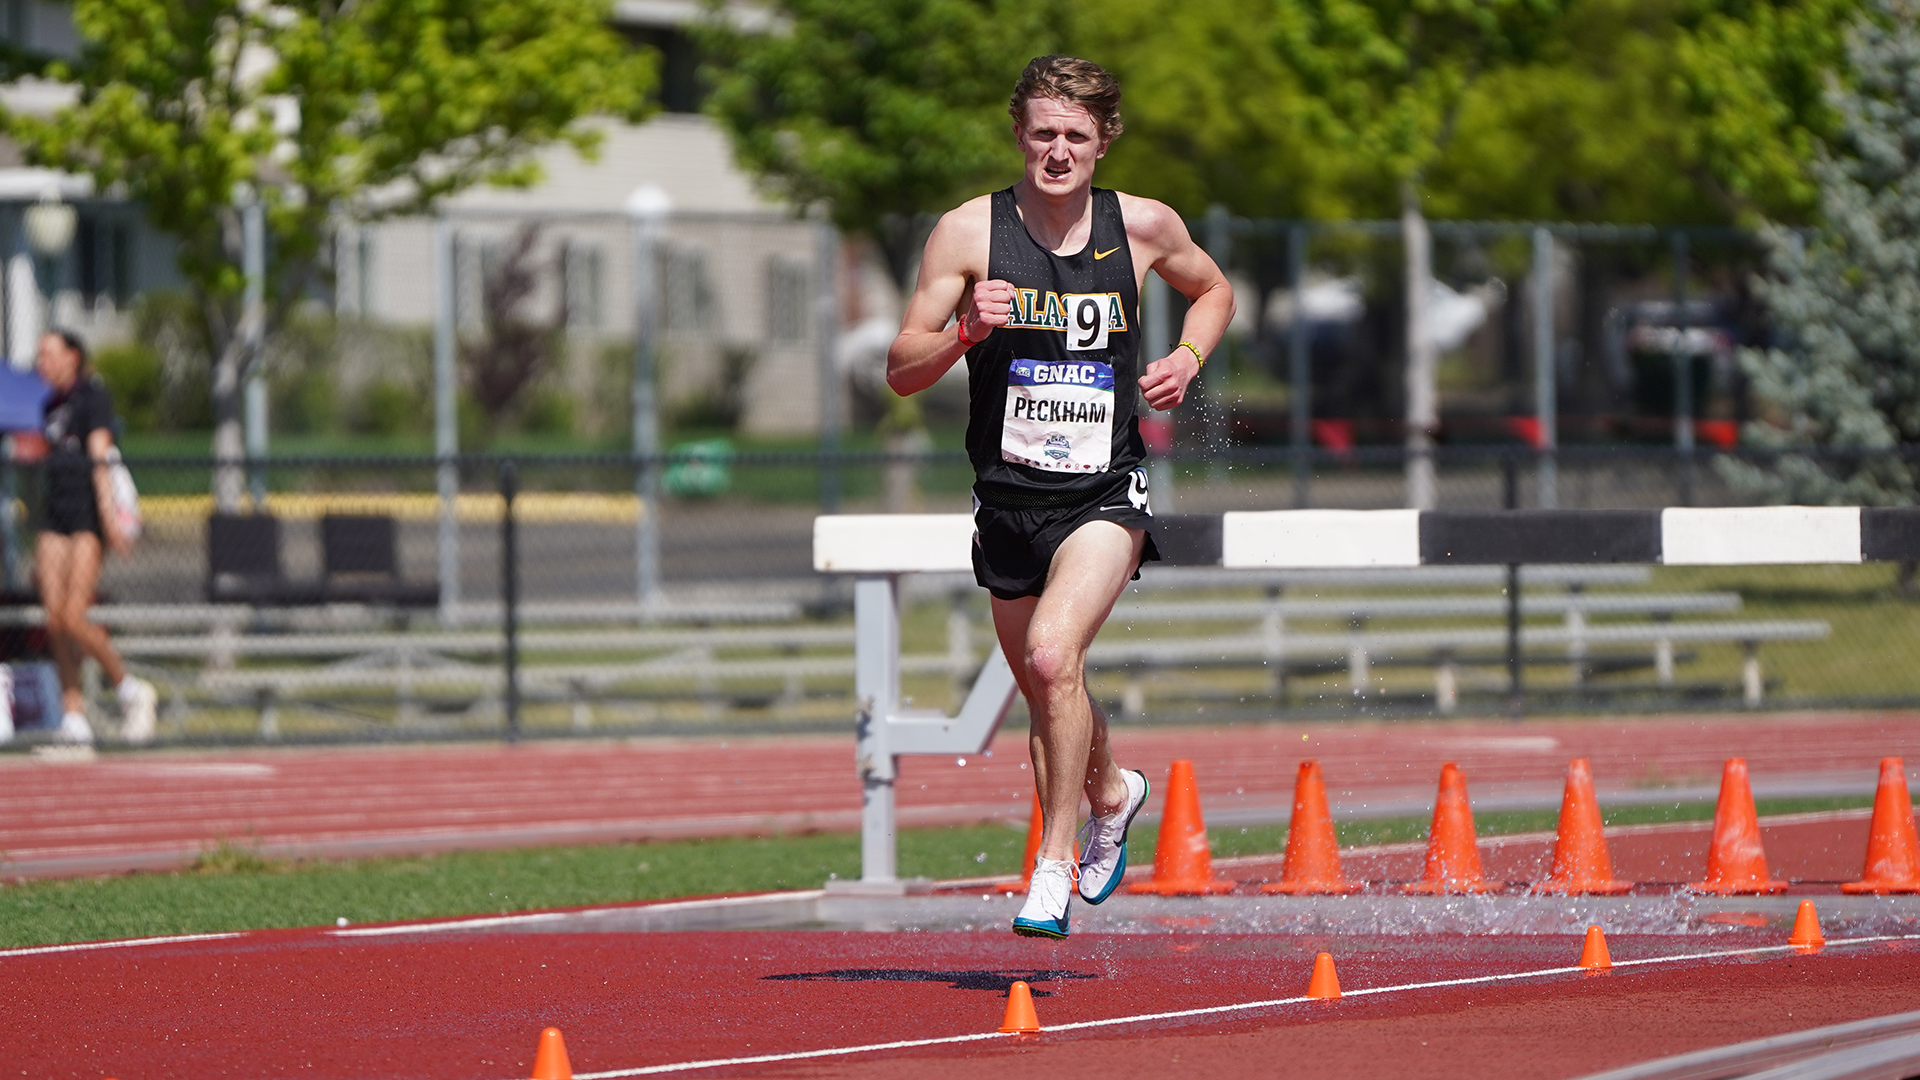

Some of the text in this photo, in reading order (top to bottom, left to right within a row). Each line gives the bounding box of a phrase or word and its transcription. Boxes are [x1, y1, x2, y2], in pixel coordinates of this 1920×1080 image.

[1003, 288, 1128, 331] ALAA
[1077, 299, 1101, 348] 9
[1033, 365, 1096, 384] GNAC
[1014, 396, 1106, 423] PECKHAM
